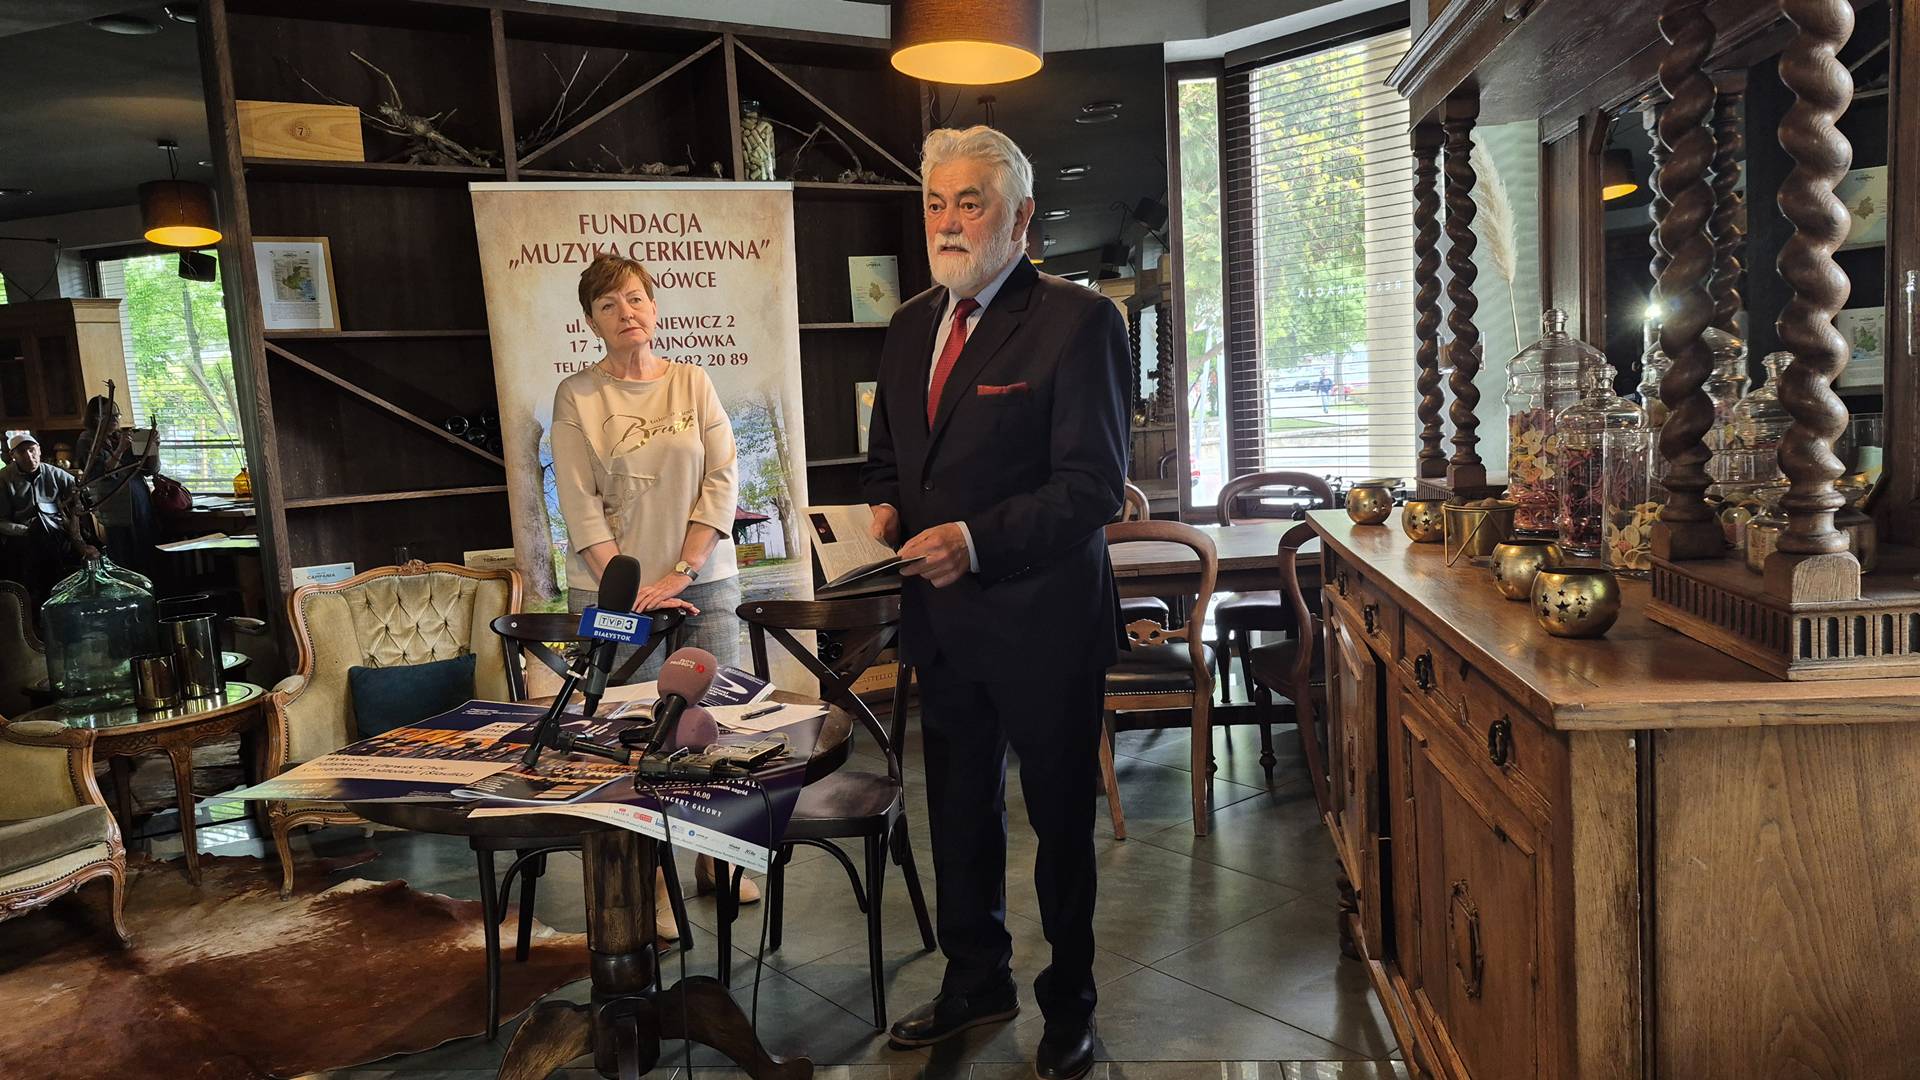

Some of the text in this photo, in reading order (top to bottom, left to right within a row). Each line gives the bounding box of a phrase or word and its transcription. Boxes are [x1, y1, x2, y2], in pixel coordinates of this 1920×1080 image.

[297, 127, 304, 136] 7
[578, 213, 703, 238] FUNDACJA
[651, 267, 718, 289] NÓWCE
[566, 315, 736, 334] ul. NIEWICZ 2
[569, 340, 589, 353] 17
[553, 361, 597, 374] TEL/F
[707, 354, 726, 367] 20
[730, 353, 749, 366] 89
[593, 630, 632, 642] BIAŁYSTOK
[692, 789, 712, 801] 16.00
[654, 795, 723, 818] ONCERT GALOWY
